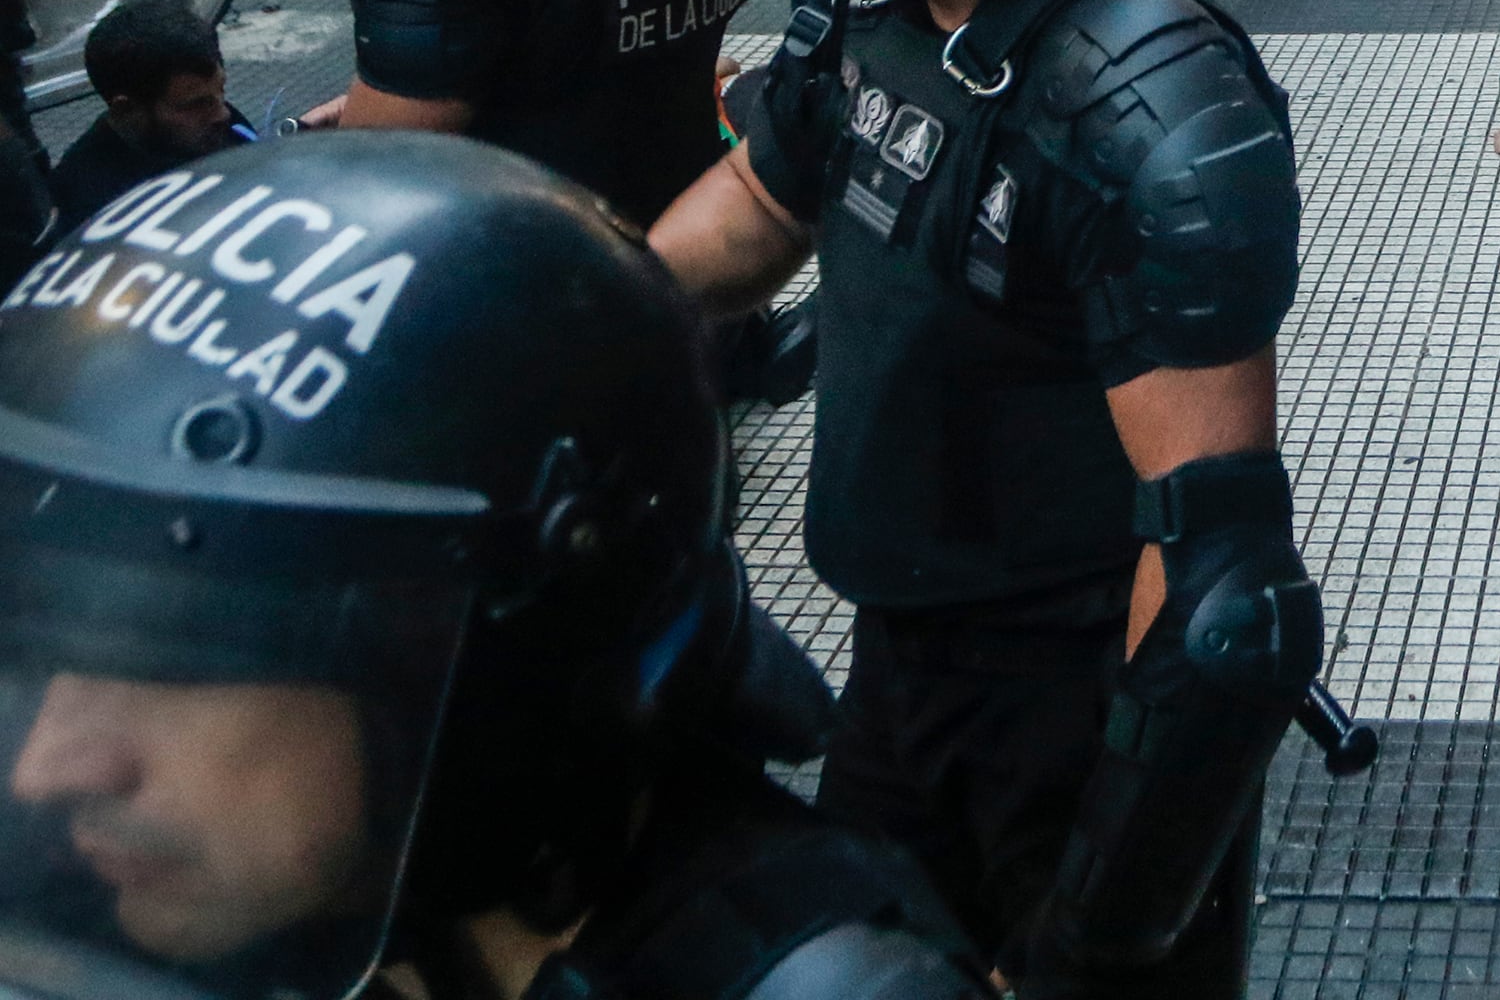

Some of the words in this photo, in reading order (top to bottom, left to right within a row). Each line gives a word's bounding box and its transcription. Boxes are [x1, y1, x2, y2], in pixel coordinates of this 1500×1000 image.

[619, 8, 657, 53] DE
[0, 252, 64, 311] E
[32, 249, 116, 307] LA
[82, 170, 416, 354] OLICIA
